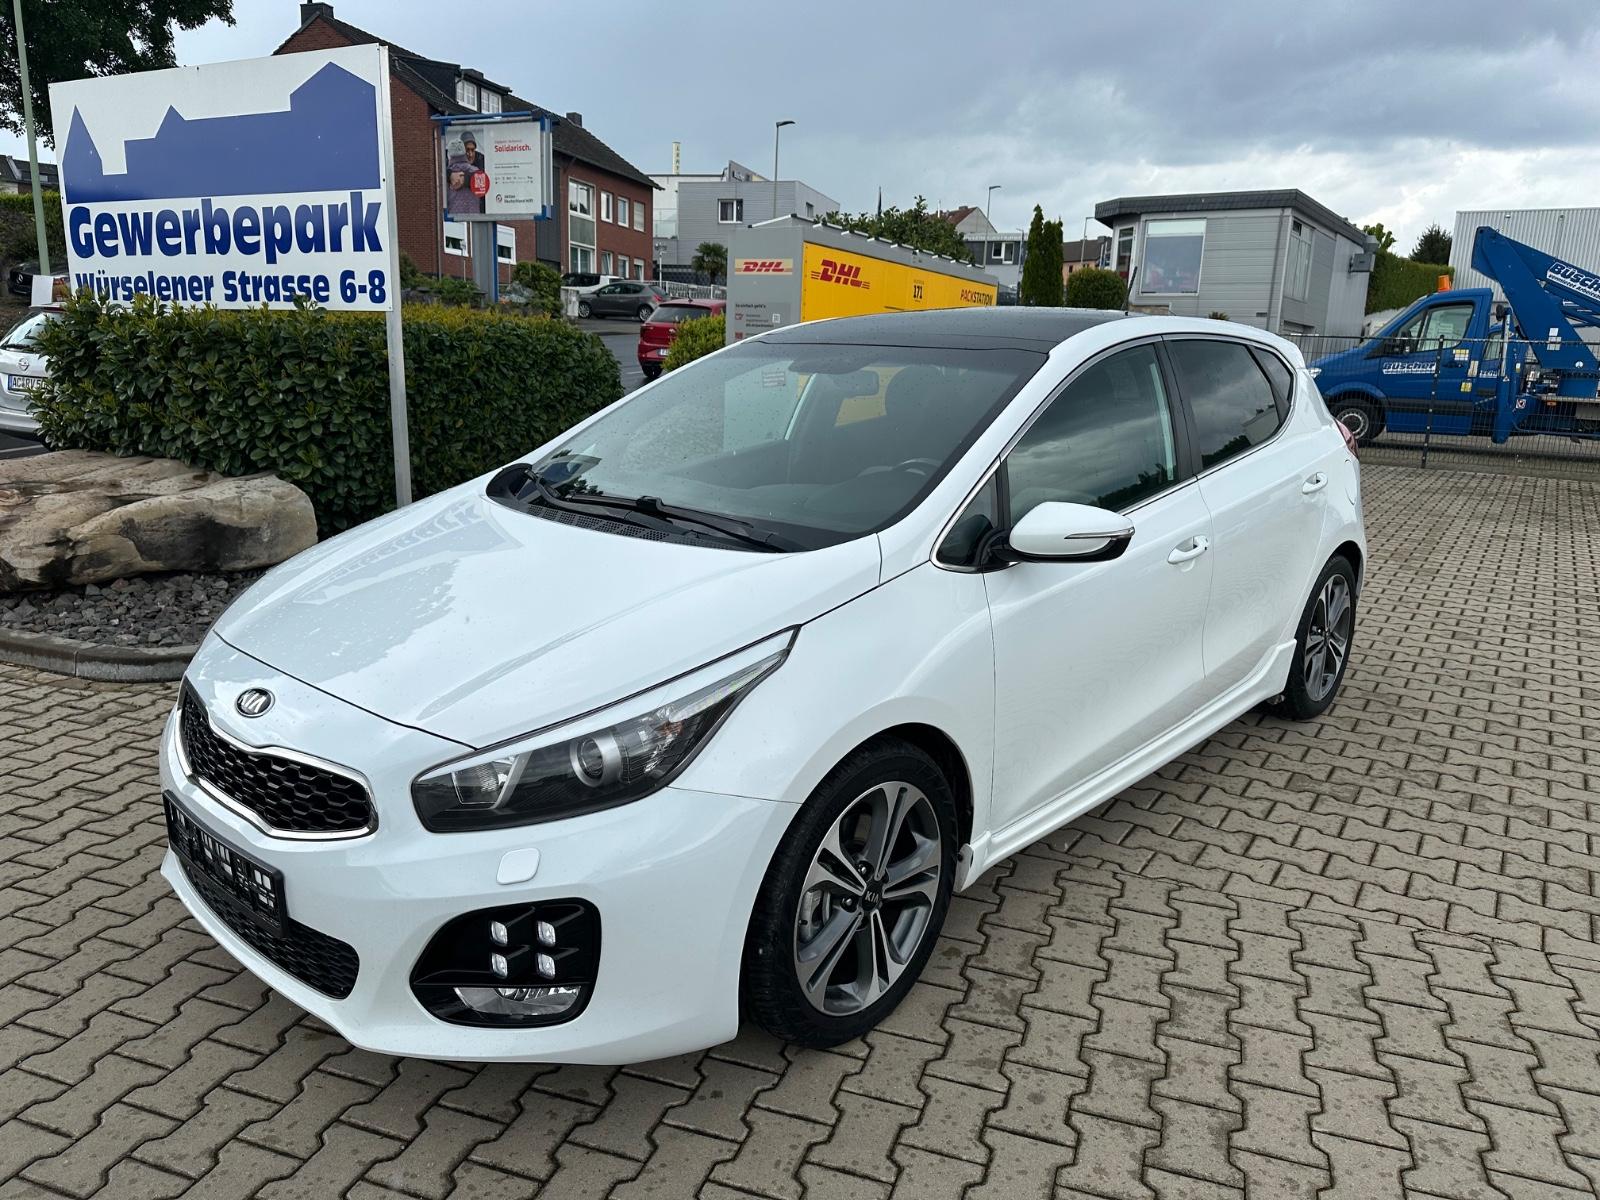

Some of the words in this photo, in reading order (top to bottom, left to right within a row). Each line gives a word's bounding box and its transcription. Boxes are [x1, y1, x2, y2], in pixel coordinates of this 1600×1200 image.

[494, 144, 531, 152] Solidarisch.
[69, 191, 384, 264] Gewerbepark
[743, 261, 785, 272] DHL
[820, 259, 863, 288] DHL
[75, 269, 214, 302] Würselener
[222, 270, 329, 302] Strasse
[339, 269, 386, 304] 6-8
[1549, 261, 1600, 293] Büsch
[913, 285, 923, 299] 171
[960, 289, 993, 306] PACKSTATION
[240, 691, 268, 714] KIA
[865, 890, 880, 905] KIA
